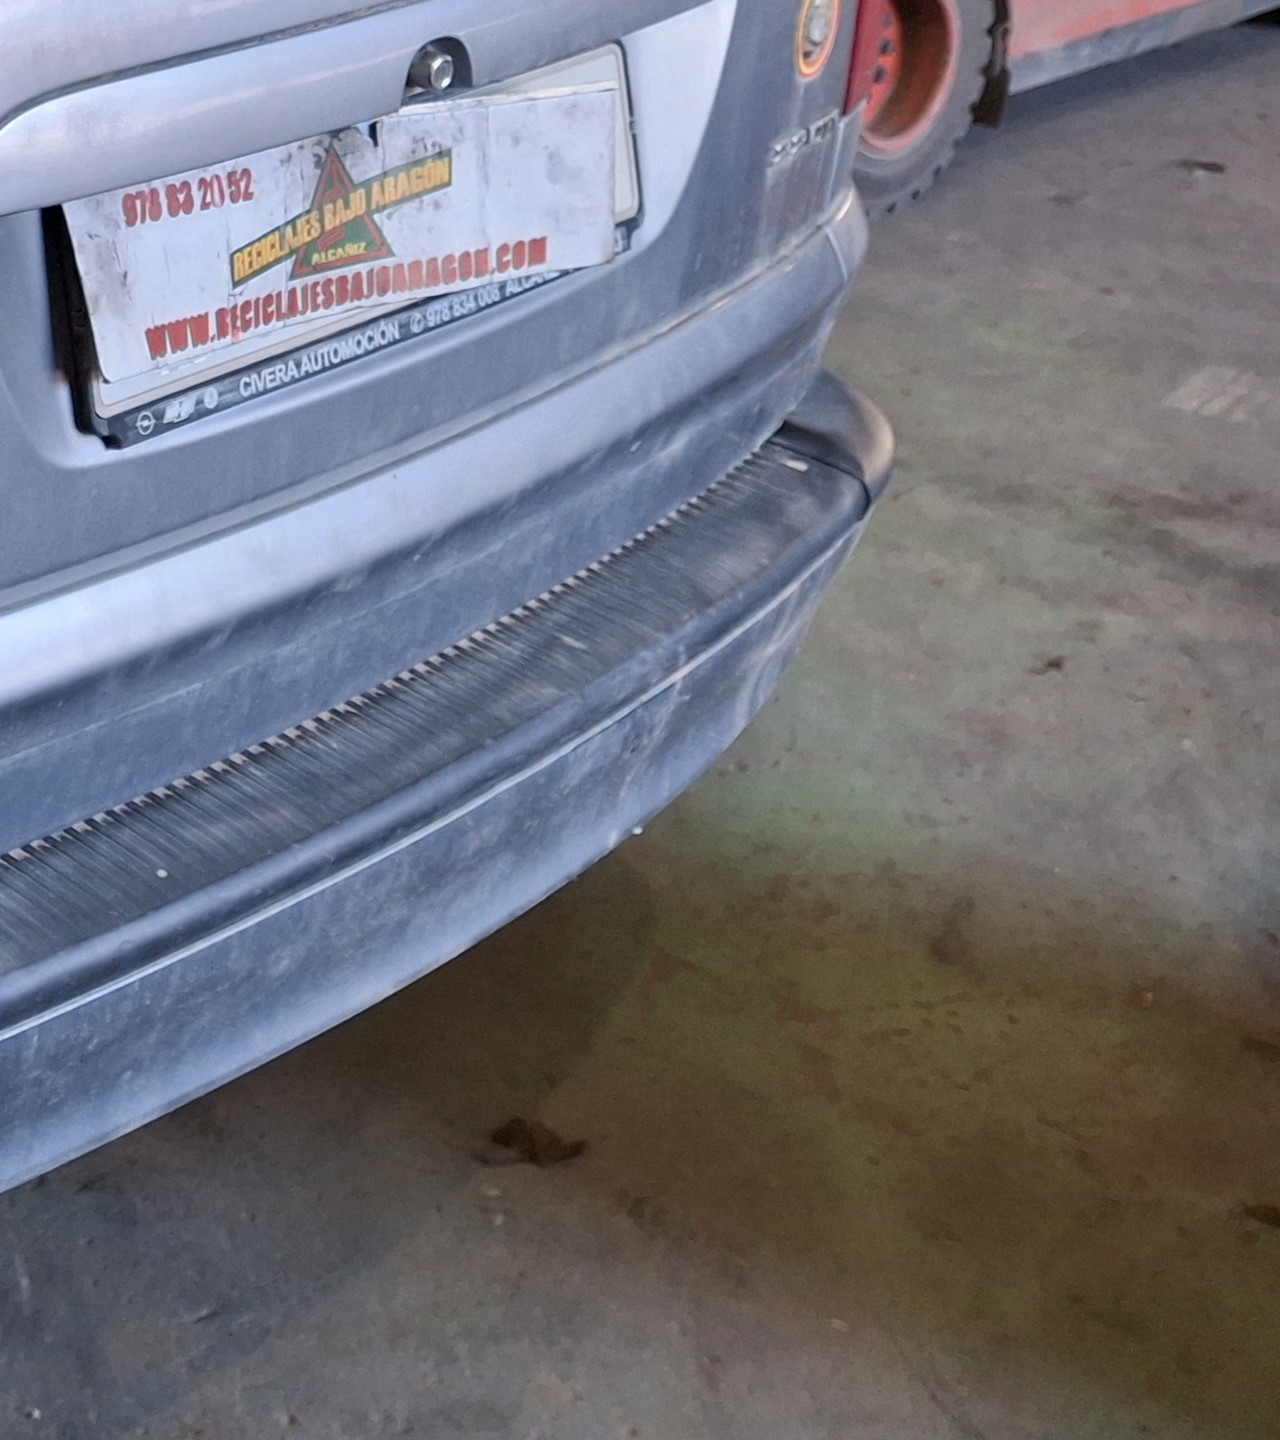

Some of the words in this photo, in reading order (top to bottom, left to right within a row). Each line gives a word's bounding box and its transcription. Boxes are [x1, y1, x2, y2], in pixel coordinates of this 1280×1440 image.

[122, 187, 163, 228] 978
[227, 167, 255, 205] 52
[233, 210, 323, 284] RECICLAJES
[323, 188, 367, 233] BAJO
[239, 363, 300, 398] CIVERA
[299, 320, 401, 373] AUTOMOCIÓN
